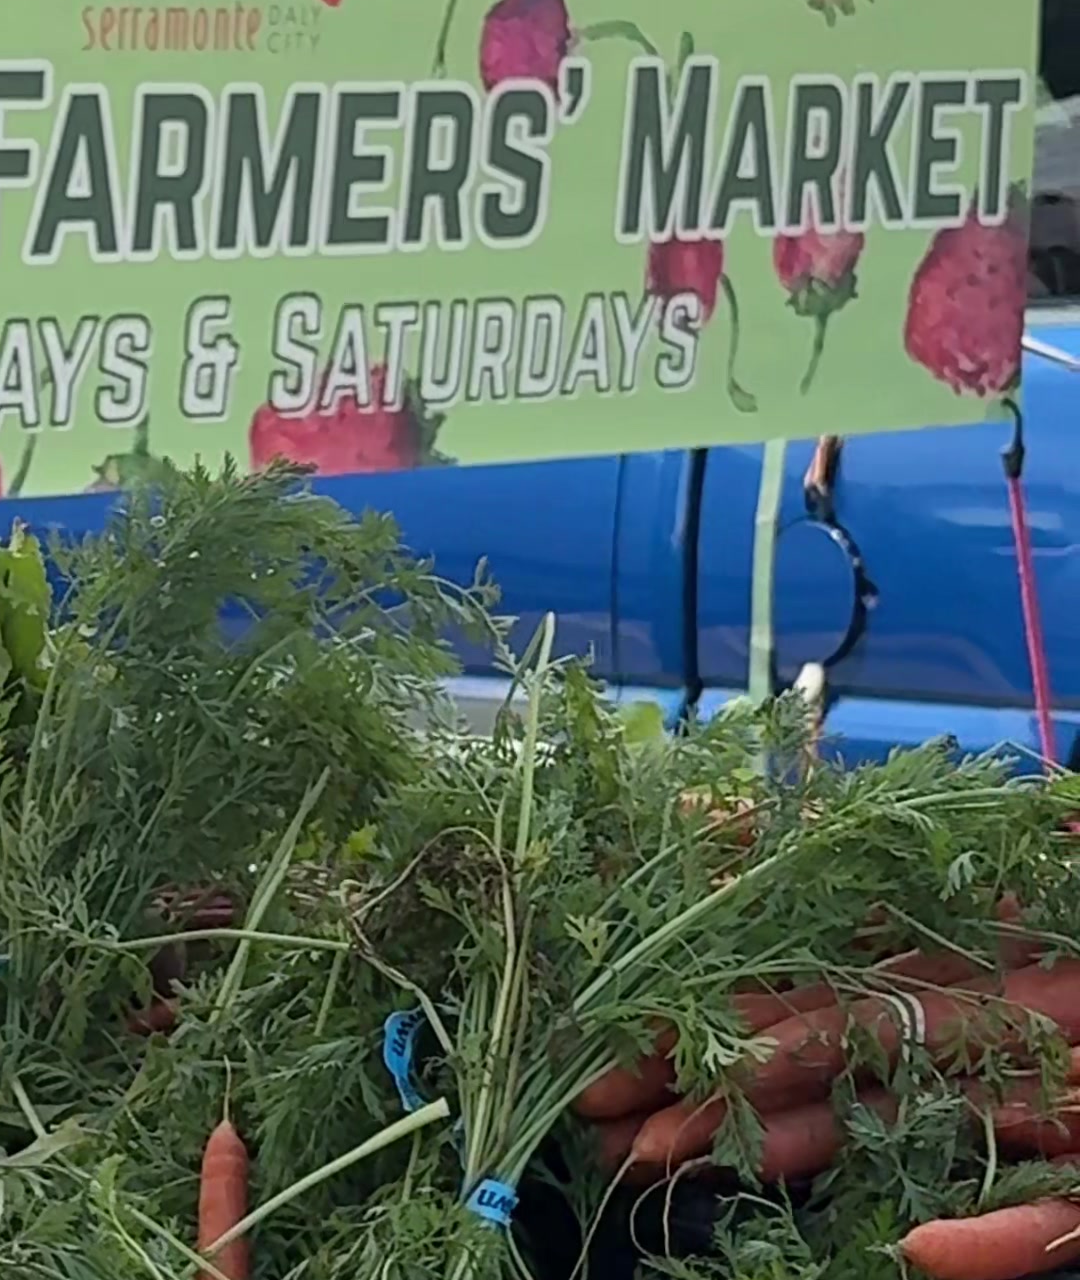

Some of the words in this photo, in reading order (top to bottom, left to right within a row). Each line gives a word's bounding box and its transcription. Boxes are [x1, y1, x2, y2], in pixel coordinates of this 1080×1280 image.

[80, 1, 263, 53] serramonte
[267, 4, 322, 26] DALY
[266, 30, 321, 54] CITY
[616, 56, 1027, 247] MARKET
[179, 294, 241, 422] &
[266, 290, 702, 416] SATURDAYS
